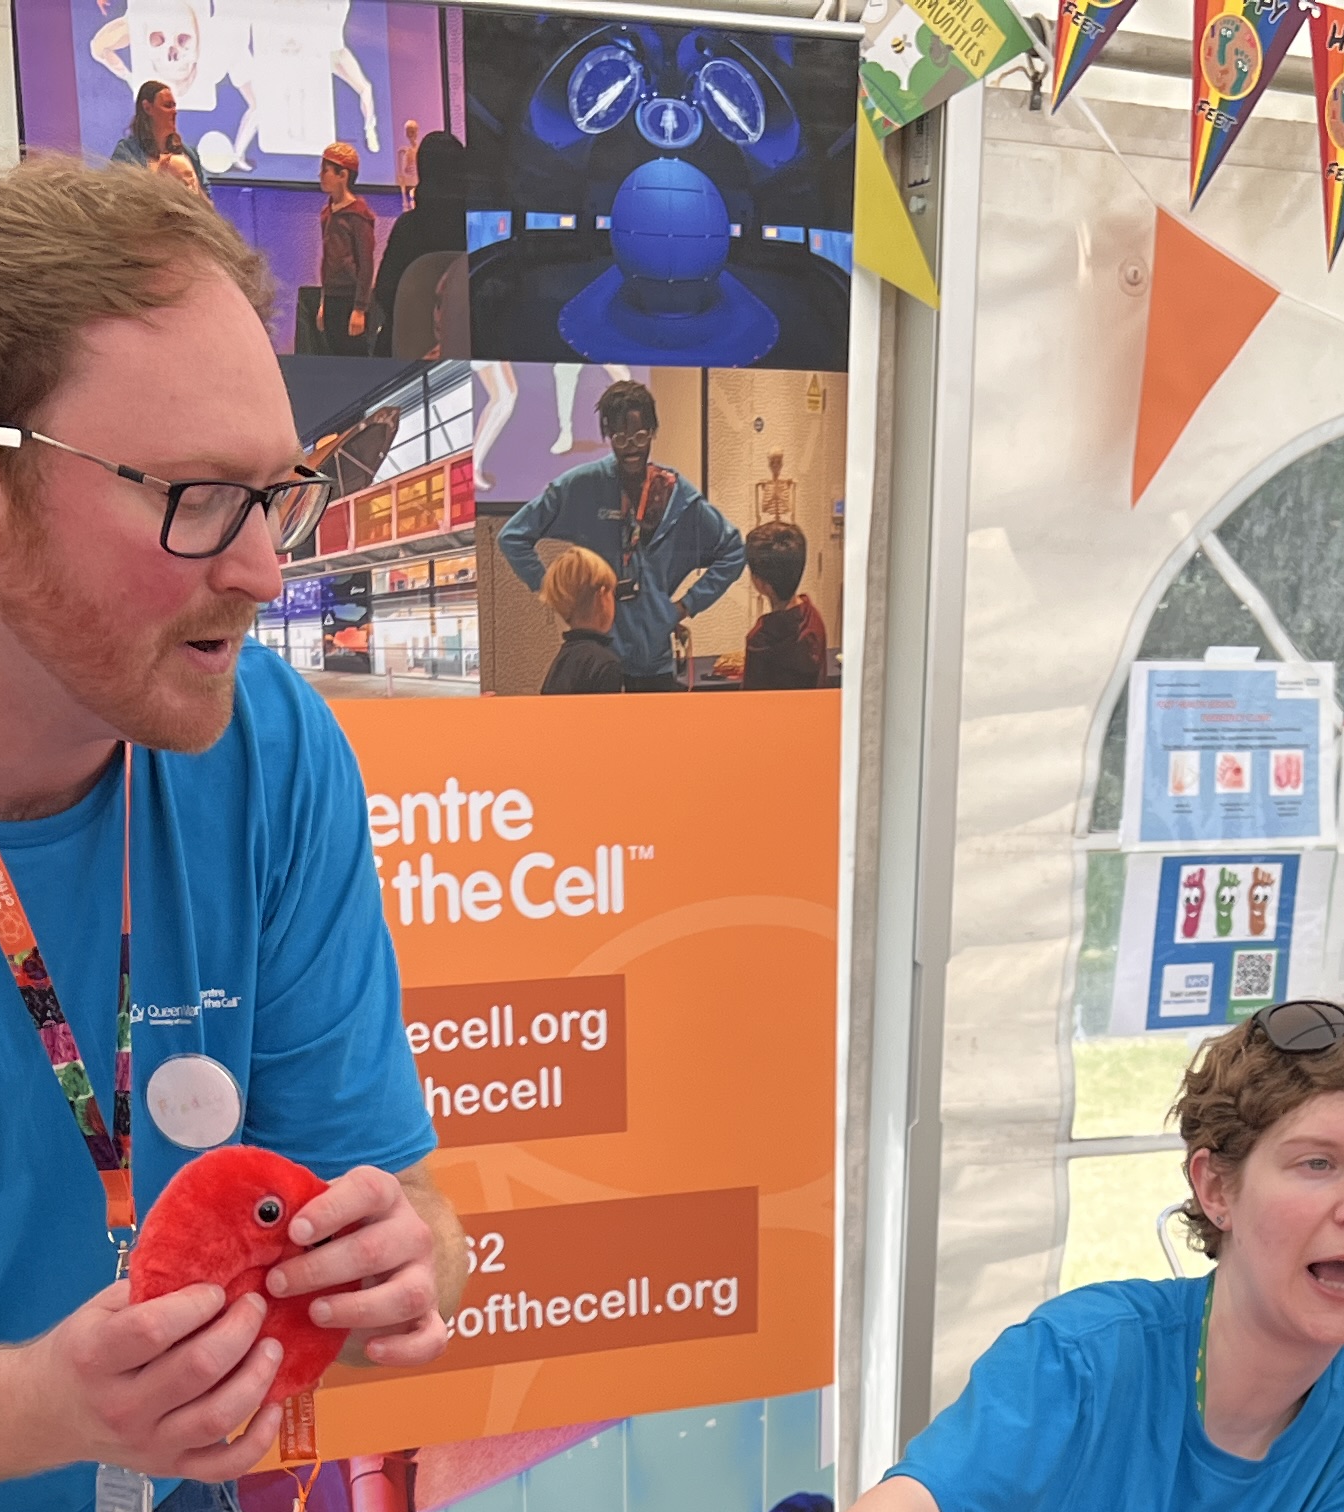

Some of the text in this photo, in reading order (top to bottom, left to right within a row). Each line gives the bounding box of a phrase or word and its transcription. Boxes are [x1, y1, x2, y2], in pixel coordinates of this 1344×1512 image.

[970, 18, 992, 38] OF
[1063, 2, 1106, 39] FEET
[1196, 100, 1238, 131] FEET
[367, 776, 533, 847] entre
[392, 852, 502, 925] the
[406, 1004, 608, 1052] ecell.org
[425, 1066, 562, 1118] hecell
[463, 1234, 506, 1273] 62
